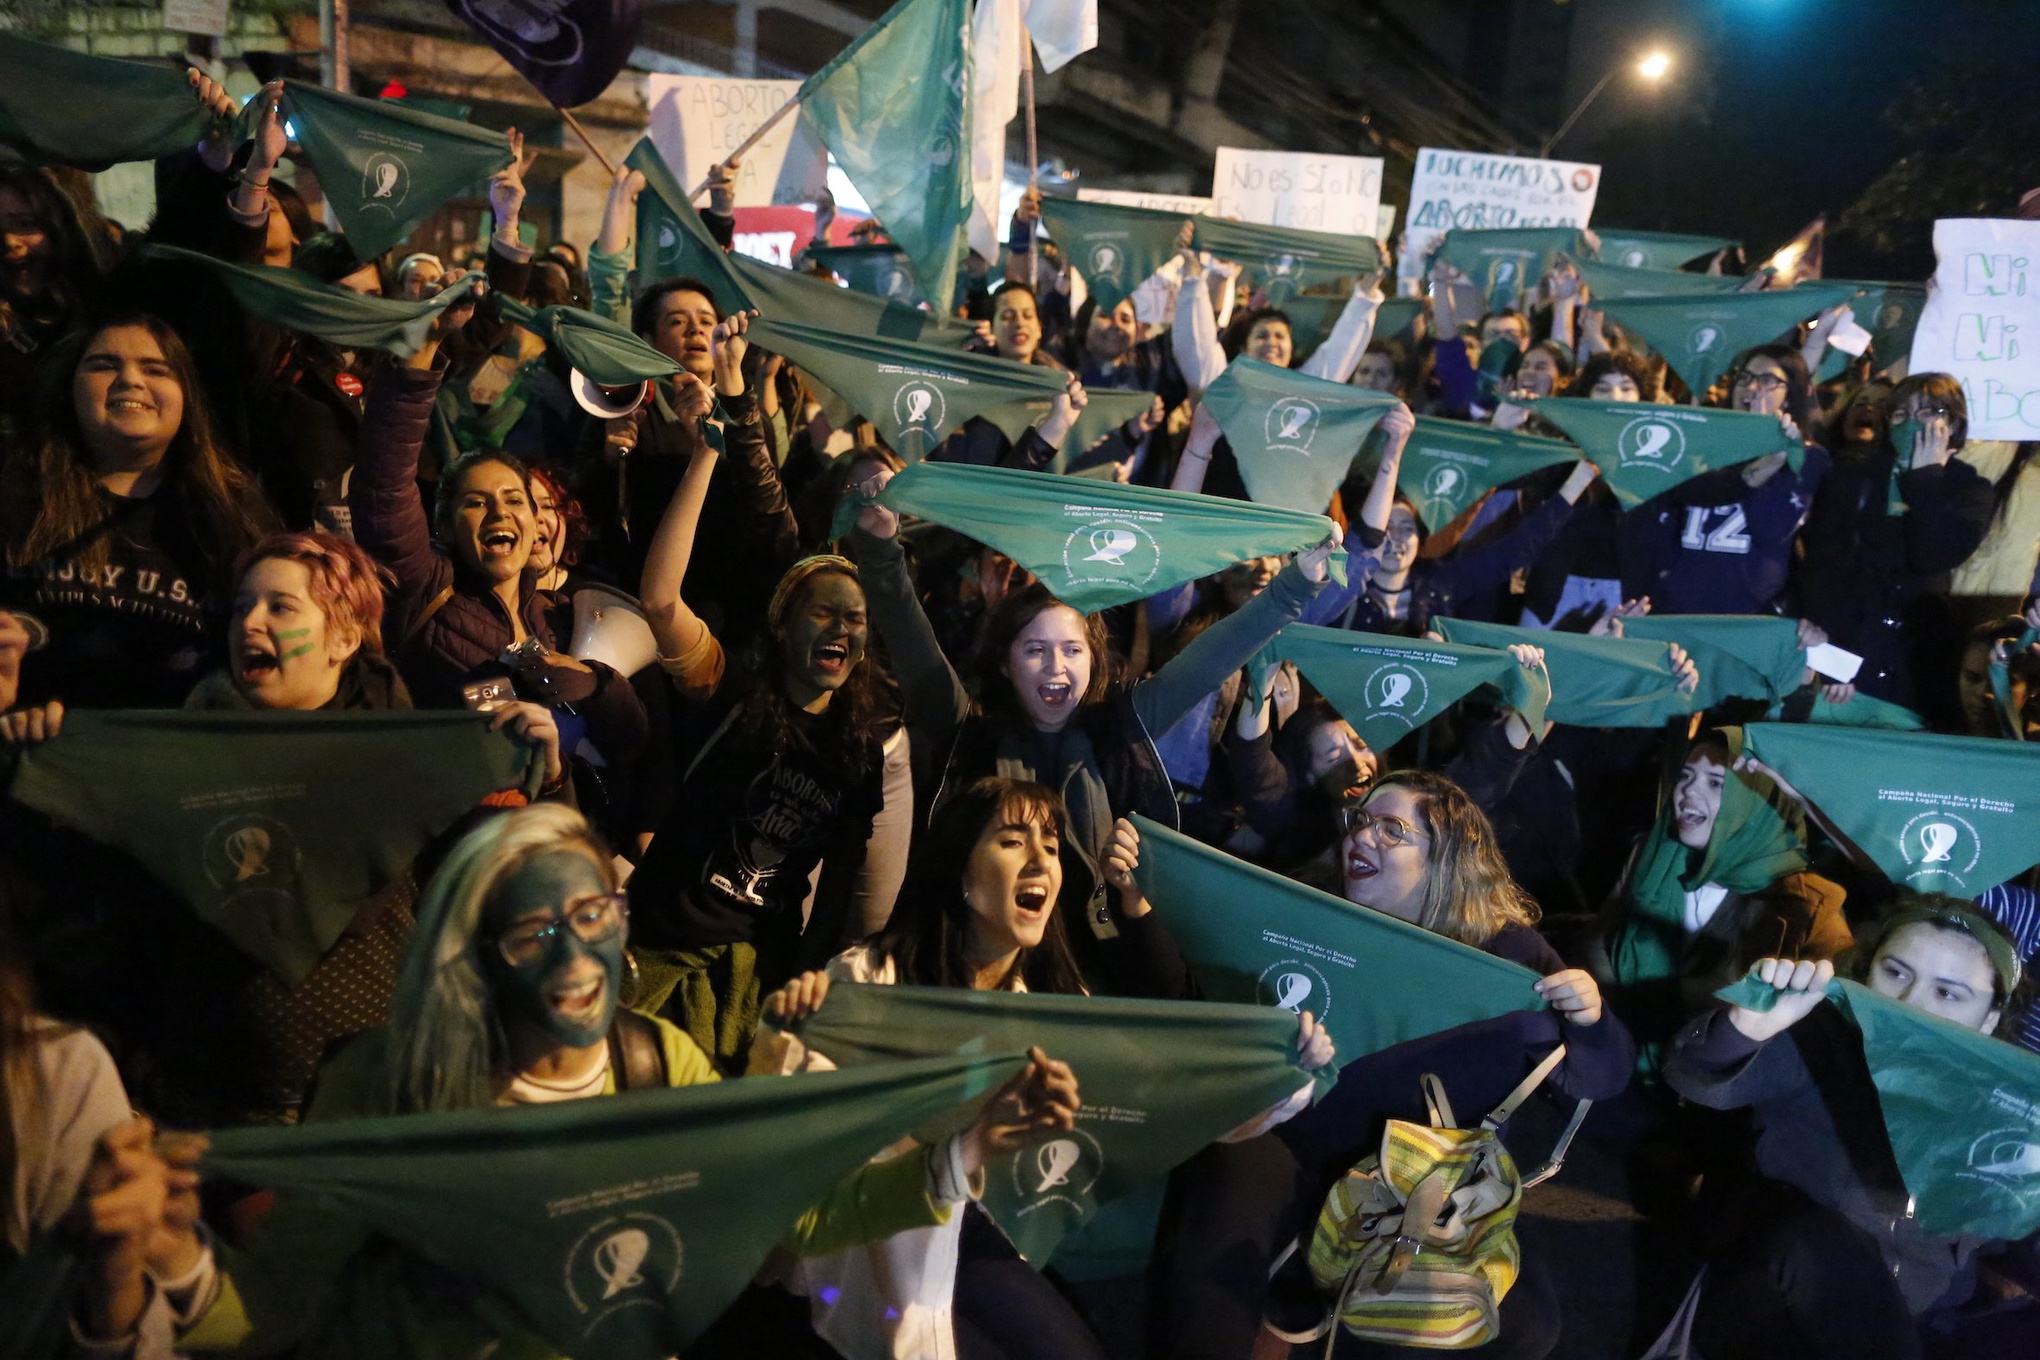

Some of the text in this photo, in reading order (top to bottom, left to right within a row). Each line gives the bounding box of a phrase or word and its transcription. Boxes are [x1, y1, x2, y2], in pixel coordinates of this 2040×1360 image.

[691, 84, 787, 118] ABORTO
[710, 121, 772, 150] LEGL
[1230, 162, 1263, 190] No
[1268, 170, 1294, 192] es
[1413, 199, 1516, 230] ABORTO
[1964, 253, 2029, 297] Ni
[1952, 313, 2019, 361] Ni
[1681, 502, 1752, 554] 12
[1878, 789, 1914, 797] Campaña
[1917, 792, 1951, 801] Nacional
[1979, 798, 2015, 808] Derecho
[1915, 797, 1939, 805] Legal,
[1941, 799, 1970, 808] Seguro
[1979, 804, 2014, 813] Gratuito
[1263, 929, 1288, 941] Campaña
[1289, 936, 1315, 949] Nacional
[1315, 944, 1325, 952] Por
[1333, 950, 1357, 963] Derecho
[1269, 937, 1288, 947] Aborto
[1289, 943, 1306, 953] Legal,
[1307, 948, 1327, 960] Seguro
[1331, 956, 1355, 969] Gratuito
